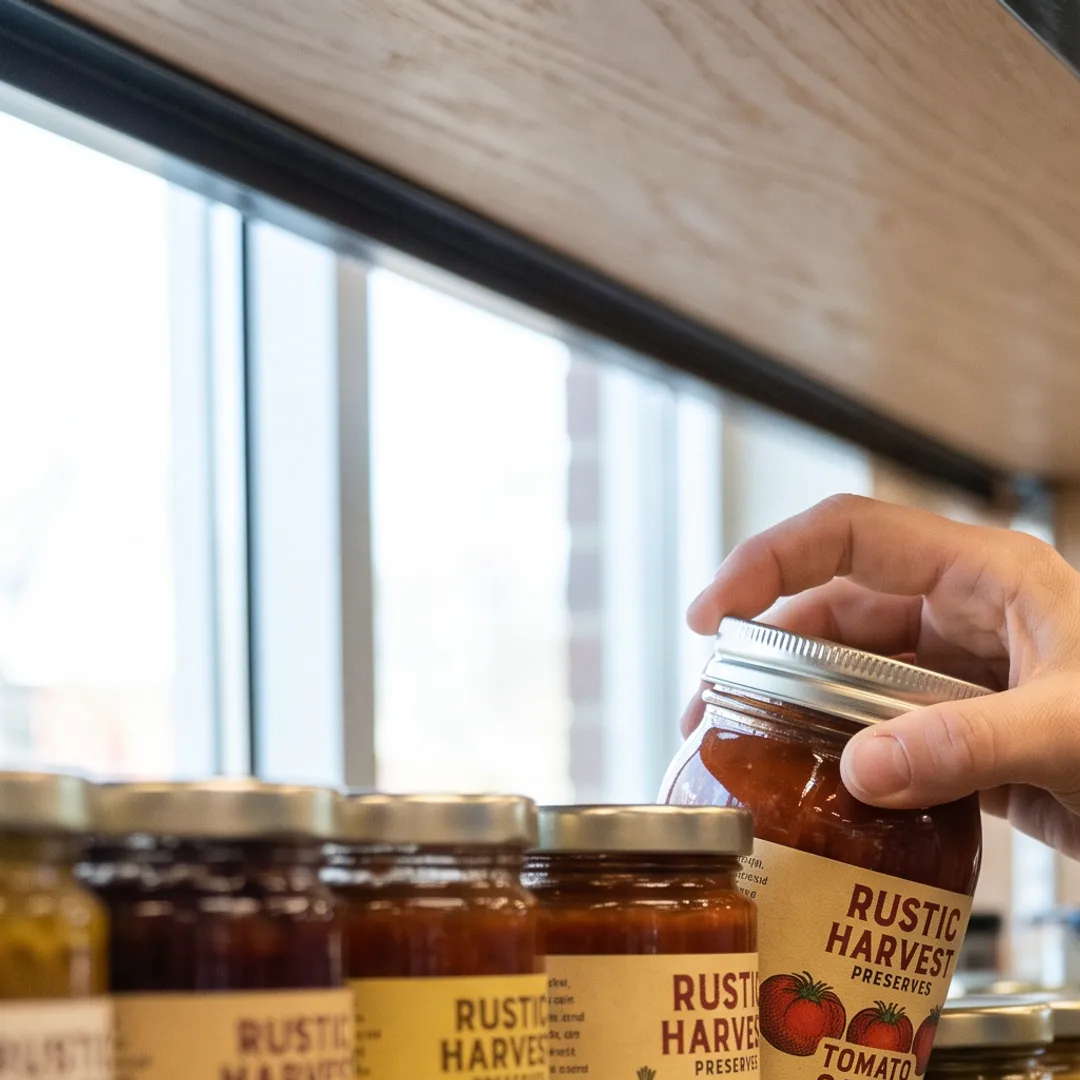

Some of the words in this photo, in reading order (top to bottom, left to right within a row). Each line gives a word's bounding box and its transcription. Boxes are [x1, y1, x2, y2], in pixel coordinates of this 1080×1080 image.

[846, 883, 961, 942] RUSTIC
[825, 921, 955, 979] HARVEST
[850, 965, 932, 996] PRESERVES
[440, 1035, 546, 1073] HARVES
[661, 1014, 759, 1055] HARVES
